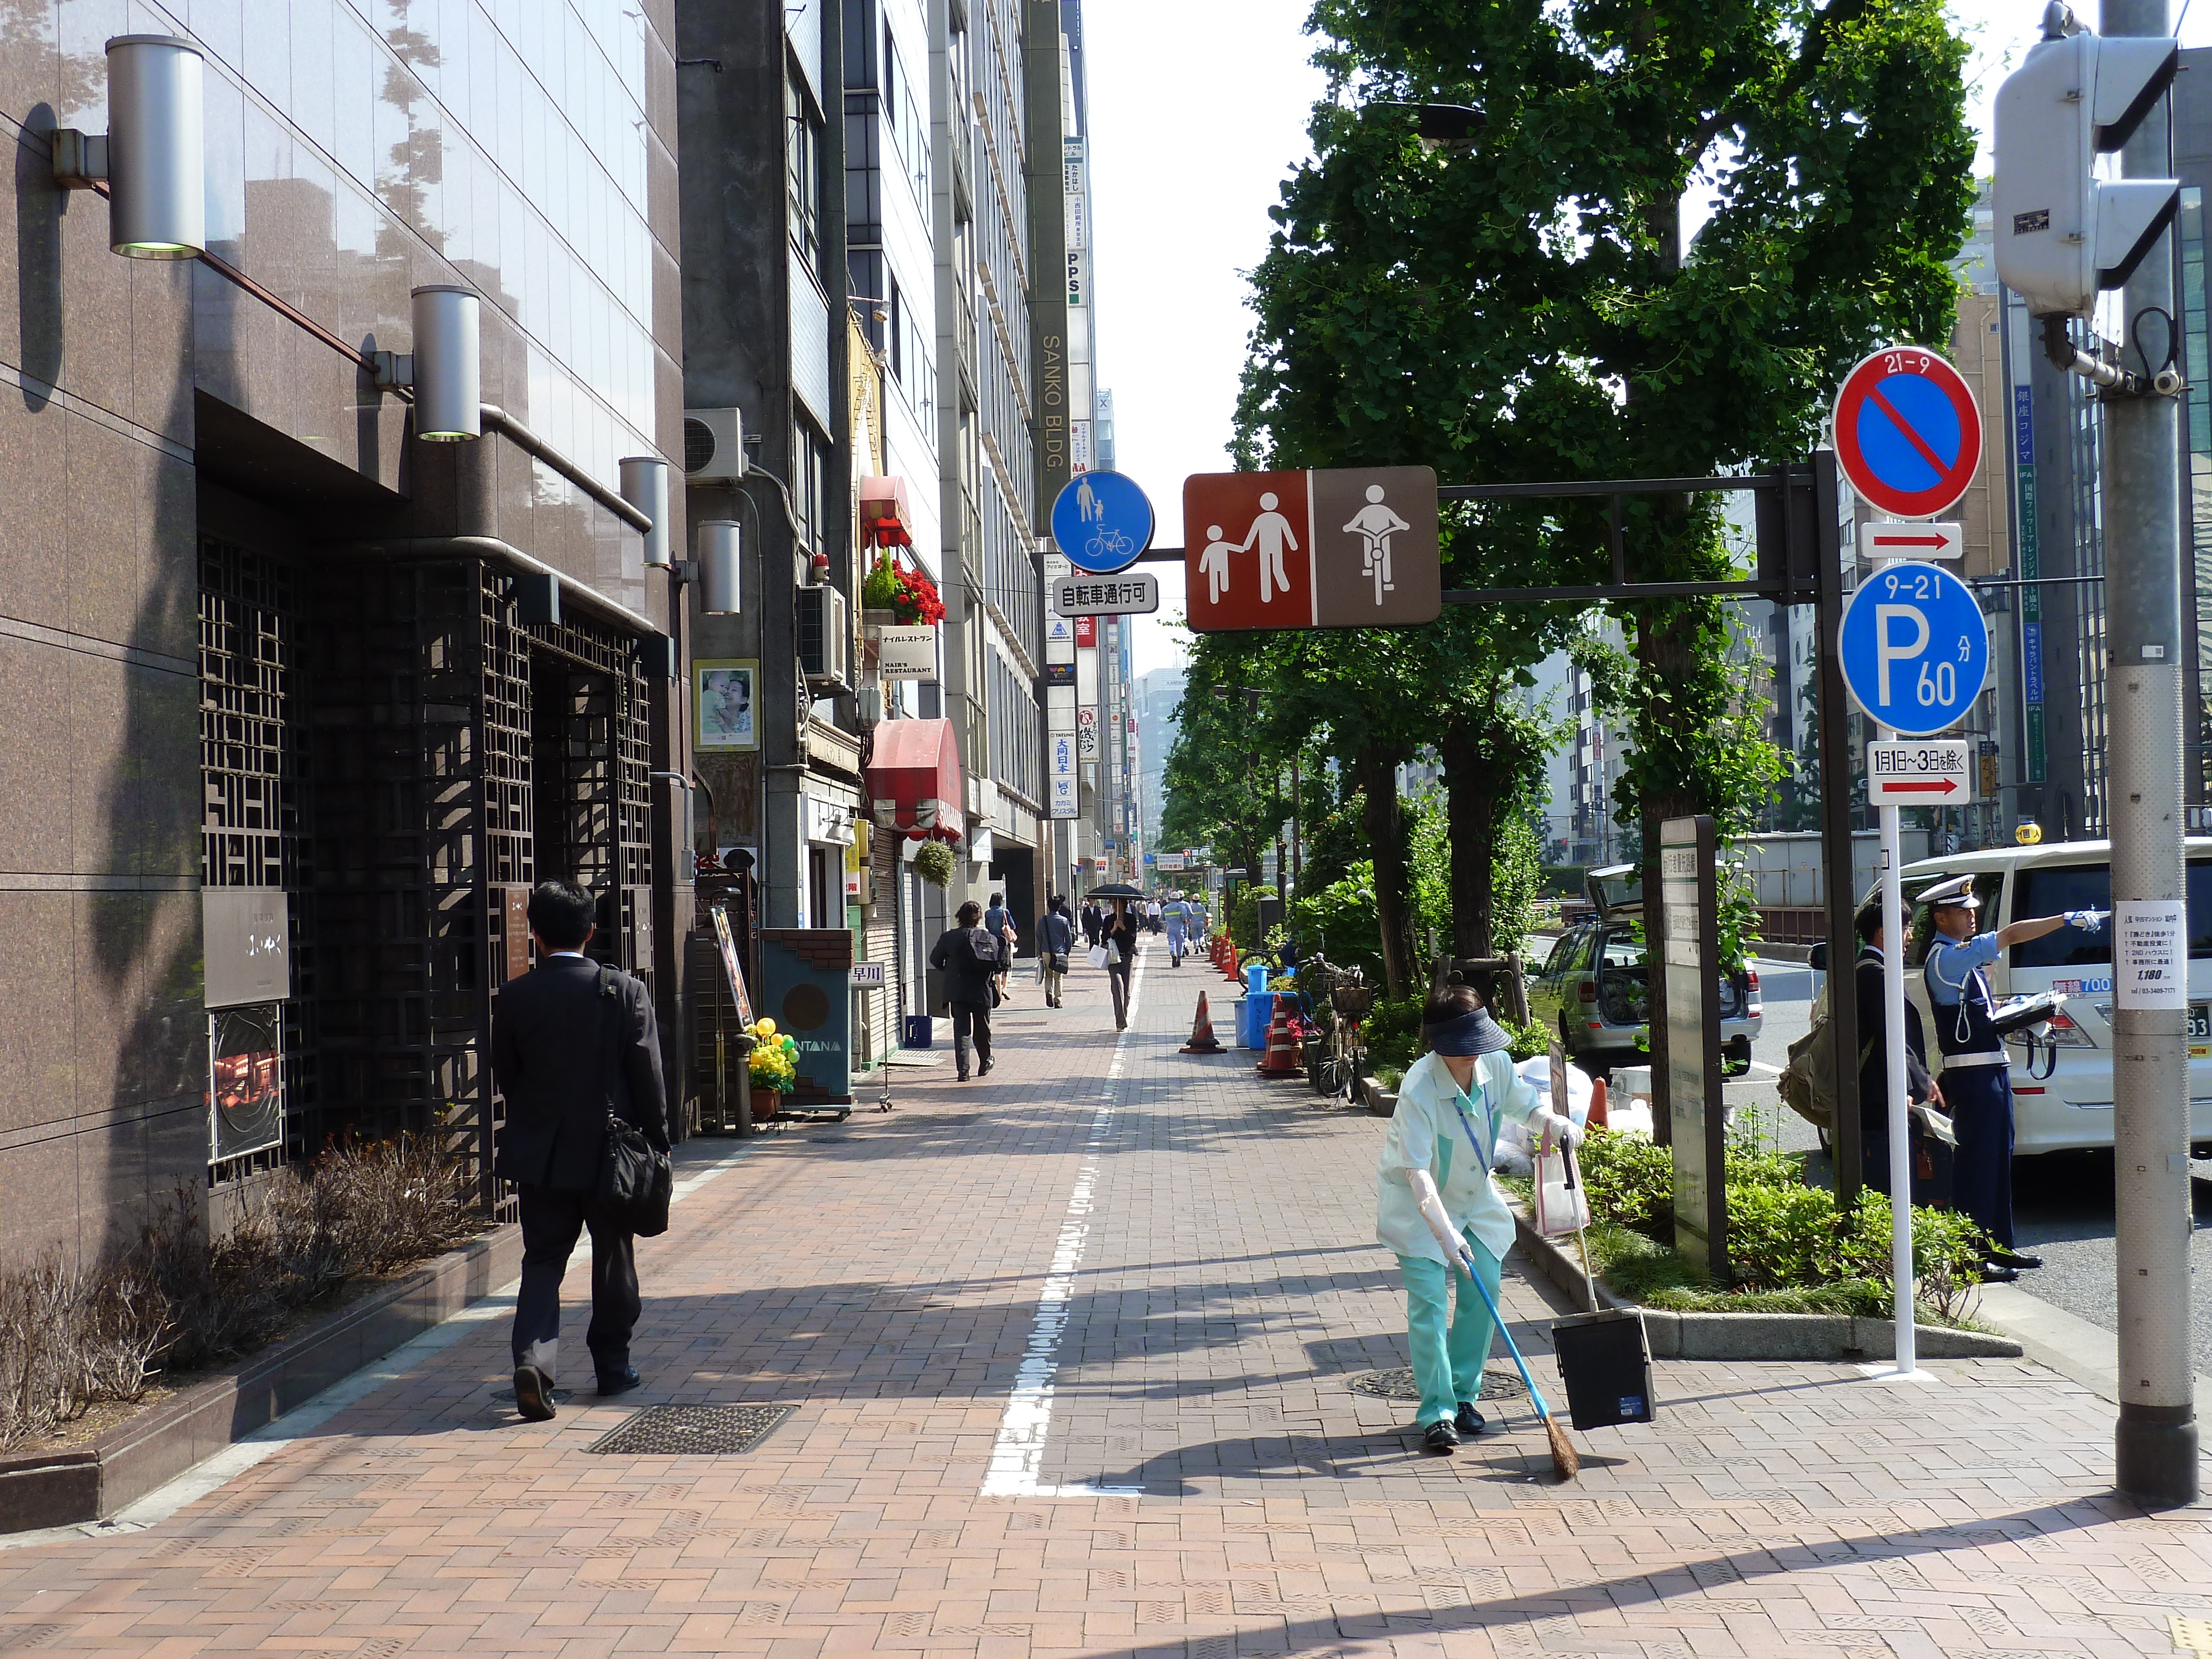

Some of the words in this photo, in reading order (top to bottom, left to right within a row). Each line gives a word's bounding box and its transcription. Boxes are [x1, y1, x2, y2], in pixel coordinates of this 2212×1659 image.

[1068, 253, 1079, 292] PPS
[1043, 335, 1062, 406] SANKO
[1885, 353, 1930, 374] 21-9
[1045, 415, 1064, 472] BLDG.
[2017, 390, 2030, 460] 銀座コジマ
[2025, 483, 2038, 612] 国際フラワーアレンジメト協会
[1062, 581, 1146, 607] 自転車通行可
[1885, 575, 1940, 599] 9-21
[1875, 604, 1930, 706] P
[1917, 661, 1956, 706] 60
[1958, 635, 1971, 662] 分
[2028, 638, 2039, 695] キャラバントラベル
[1057, 739, 1070, 774] 大同日本
[1874, 750, 1964, 772] 1月1日～3日を除く
[2019, 829, 2040, 839] 個人
[853, 967, 880, 981] 早川
[2054, 980, 2081, 993] 無線
